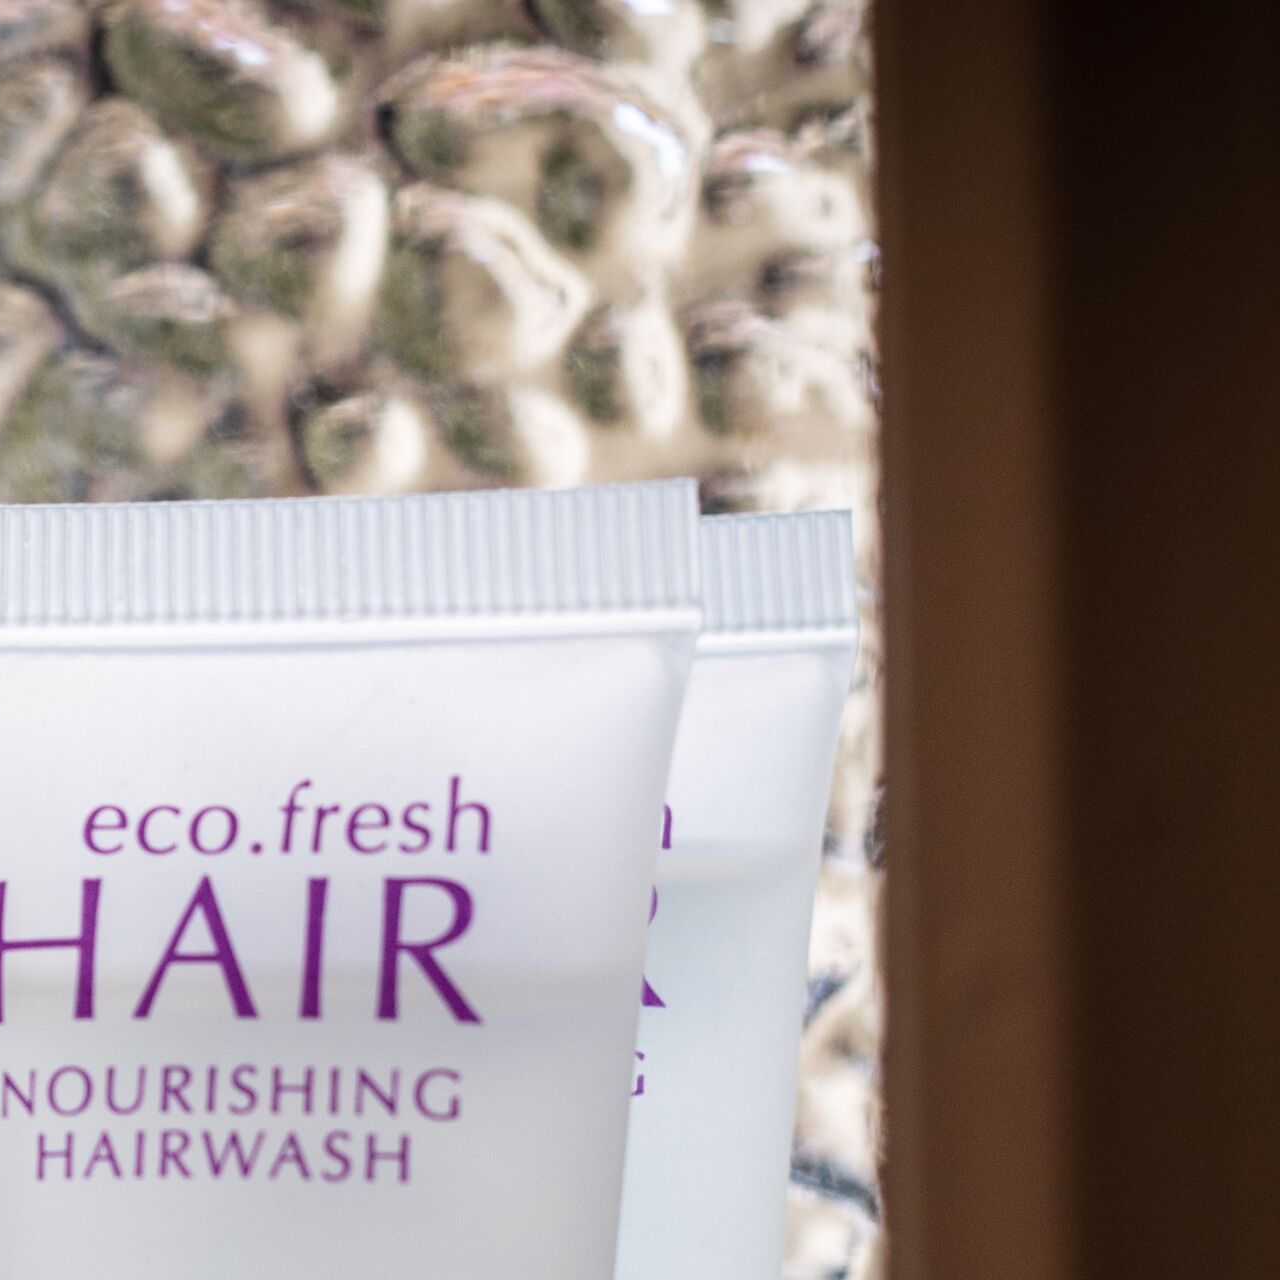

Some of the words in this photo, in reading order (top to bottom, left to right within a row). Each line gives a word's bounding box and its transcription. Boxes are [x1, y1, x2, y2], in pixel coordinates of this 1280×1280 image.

[82, 775, 493, 856] eco.fresh
[1, 1064, 463, 1123] NOURISHING
[36, 1129, 411, 1184] HAIRWASH
